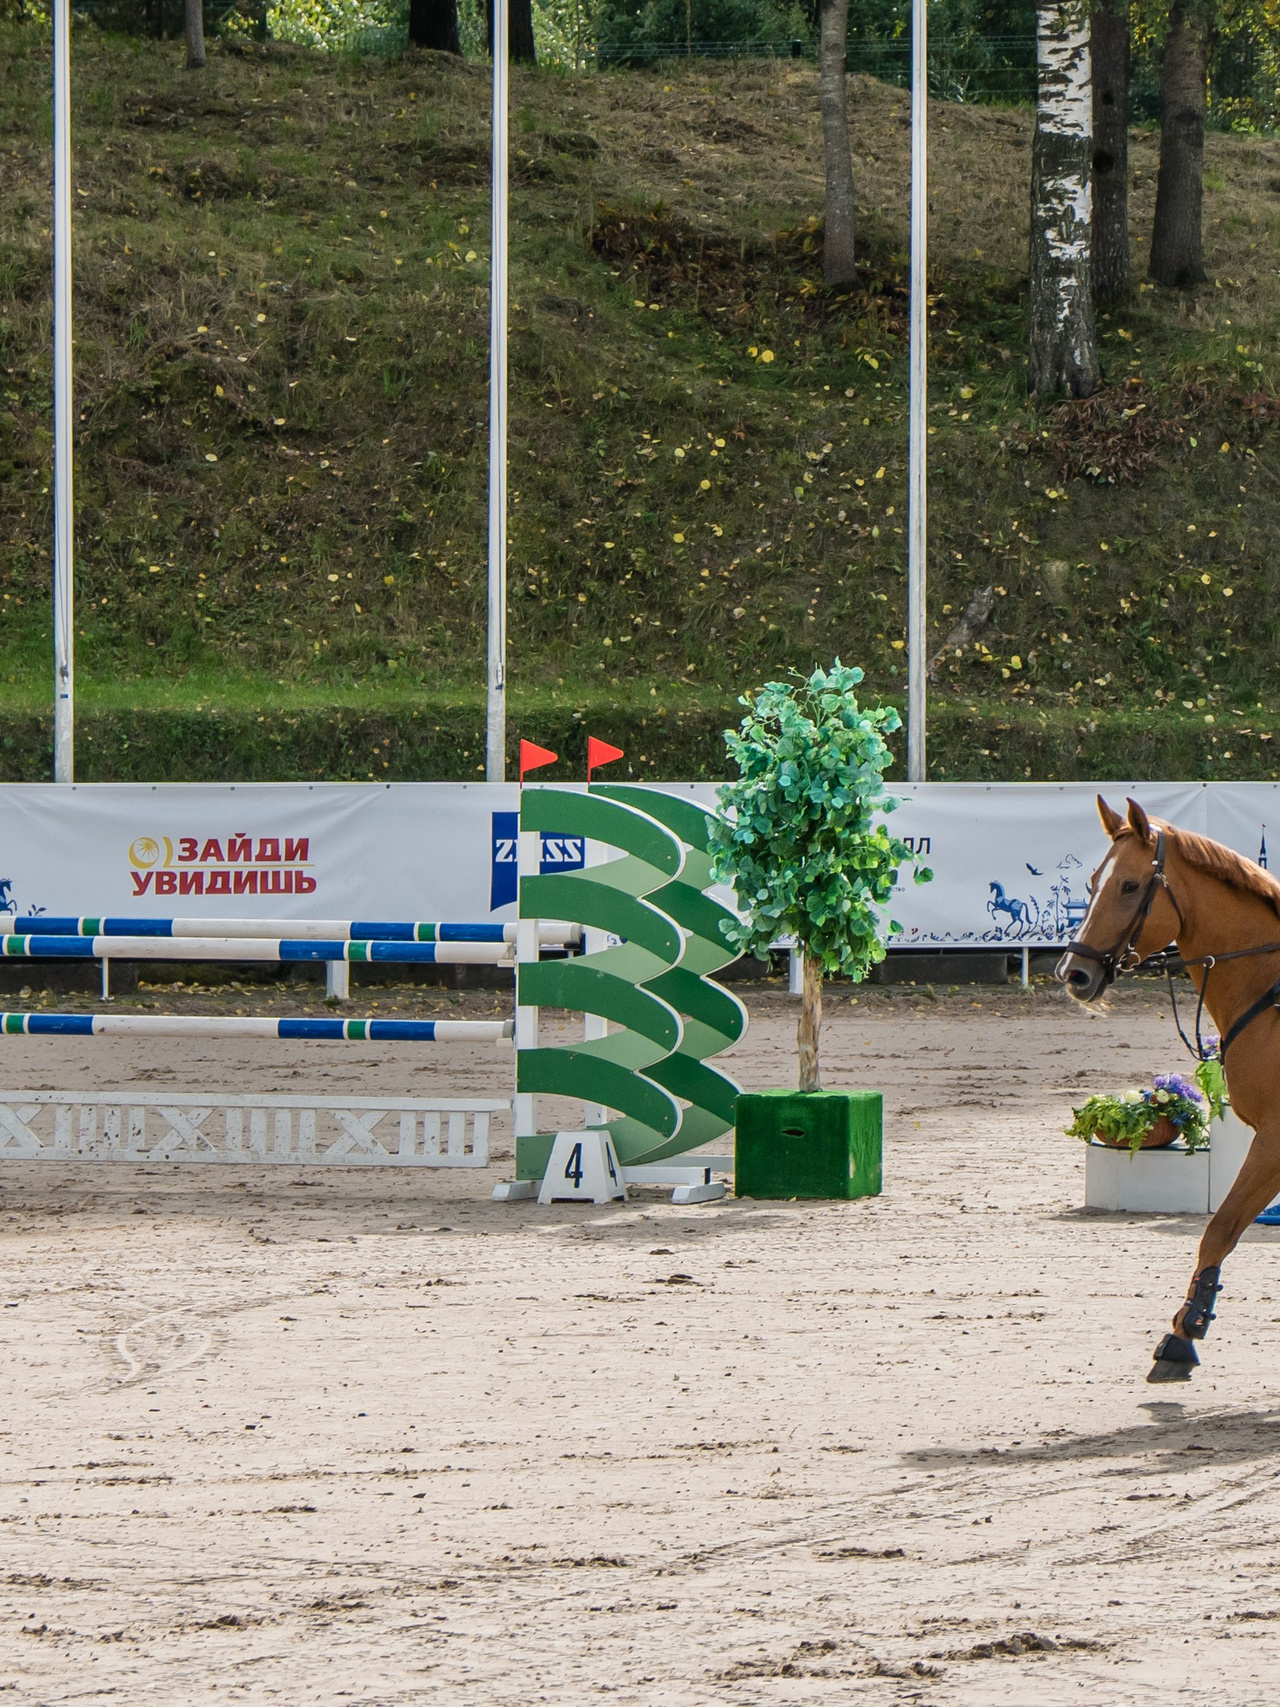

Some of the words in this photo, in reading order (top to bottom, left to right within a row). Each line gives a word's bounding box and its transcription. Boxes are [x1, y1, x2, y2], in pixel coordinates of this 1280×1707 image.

[177, 832, 310, 862] ЗАЙДИ
[495, 838, 582, 863] ZSS
[130, 870, 317, 896] УВИДИШЬ
[565, 1142, 584, 1189] 4
[605, 1141, 618, 1187] 4
